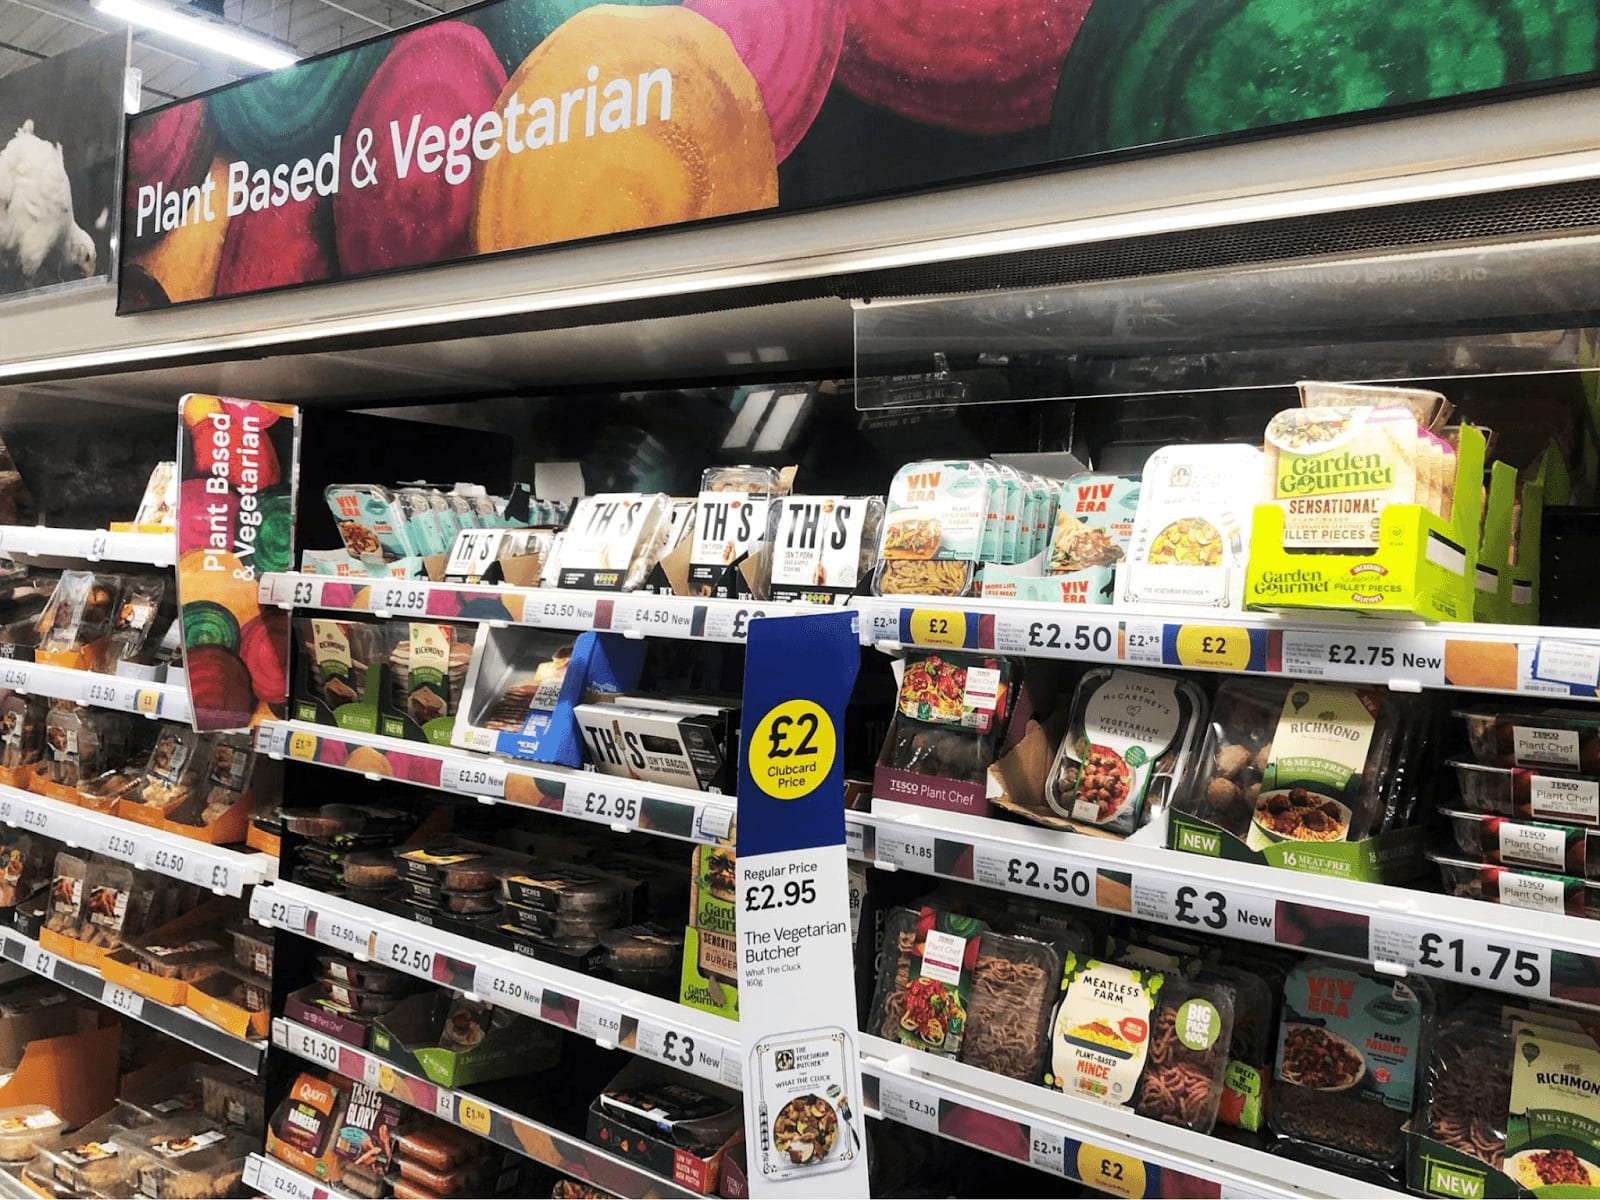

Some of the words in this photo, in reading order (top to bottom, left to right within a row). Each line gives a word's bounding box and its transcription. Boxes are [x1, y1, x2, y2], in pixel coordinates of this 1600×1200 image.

[135, 175, 216, 238] Plant
[226, 136, 340, 217] Based
[351, 128, 378, 189] &
[390, 66, 675, 185] Vegetarian
[206, 413, 230, 494] Based
[1292, 451, 1381, 476] Garden
[234, 416, 263, 558] Vegetarian
[907, 472, 942, 489] VIV
[1280, 466, 1392, 494] Gourmet
[1078, 483, 1115, 500] VIV
[1076, 501, 1107, 513] ERA
[1289, 498, 1379, 515] SENSATIONAL
[204, 503, 228, 572] Plant
[1321, 529, 1365, 540] PIECES
[232, 565, 255, 581] &
[1262, 569, 1322, 584] Garden
[294, 582, 312, 604] £3
[1061, 581, 1089, 593] VIV
[1255, 580, 1328, 597] Gourmet
[1334, 583, 1365, 592] FILLET
[1368, 584, 1402, 593] PIECES
[385, 590, 425, 610] £2.95
[1063, 594, 1087, 604] ERA
[543, 604, 574, 618] £3.50
[576, 608, 593, 619] New
[635, 608, 669, 624] £4.50
[671, 614, 690, 627] New
[873, 617, 898, 628] £2.50
[929, 618, 947, 634] £2
[1028, 622, 1112, 652] £2.50
[1129, 634, 1160, 648] £2.95
[1202, 636, 1226, 654] £2
[1328, 644, 1395, 667] £2.75
[1402, 652, 1442, 669] New
[90, 685, 116, 702] £3.50
[1125, 684, 1156, 695] LINDA
[385, 722, 404, 736] NEW
[1100, 715, 1159, 735] VEGETARIAN
[1100, 725, 1153, 743] MEATBALLS
[1290, 722, 1361, 742] RICHMOND
[767, 712, 819, 759] £2
[1519, 740, 1546, 751] Plant
[1547, 742, 1574, 753] Chef
[459, 770, 487, 785] £2.50
[488, 776, 504, 787] New
[767, 762, 817, 777] Clubcard
[778, 777, 806, 789] Price
[890, 779, 919, 793] TESCO
[920, 784, 947, 801] Plant
[948, 790, 975, 806] Chef
[585, 792, 637, 821] £2.95
[1536, 790, 1564, 801] Plant
[1566, 793, 1594, 804] Chef
[24, 809, 47, 828] £2.50
[108, 835, 136, 857] £2.50
[904, 842, 932, 859] £1.85
[1183, 832, 1217, 851] NEW
[1504, 838, 1531, 850] Plant
[1533, 842, 1560, 855] Chef
[155, 850, 185, 873] £2.50
[1282, 851, 1297, 867] 16
[1298, 854, 1352, 873] MEAT-FREE
[211, 864, 229, 889] £3
[744, 866, 785, 882] Regular
[788, 862, 818, 875] Price
[1007, 858, 1090, 897] £2.50
[745, 878, 816, 912] £2.95
[1504, 887, 1530, 900] Plant
[1532, 892, 1559, 904] Chef
[704, 901, 737, 920] Gard
[1175, 886, 1228, 930] £3
[1237, 908, 1273, 929] New
[331, 924, 354, 942] £2.50
[744, 931, 771, 945] The
[773, 920, 847, 943] Vegetarian
[703, 932, 737, 953] SENSATIO
[36, 953, 50, 973] £2
[391, 943, 431, 973] £2.50
[745, 944, 801, 963] Butcher
[1419, 932, 1541, 988] £1.75
[745, 968, 765, 978] What
[767, 965, 780, 975] The
[781, 962, 802, 973] Cluck
[493, 978, 522, 998] £2.50
[523, 990, 541, 1004] New
[1083, 975, 1140, 998] MEATLESS
[1093, 988, 1124, 1004] FARM
[1307, 976, 1356, 1000] VIV
[1187, 1003, 1211, 1024] BIG
[1307, 995, 1350, 1019] ERA
[598, 1016, 619, 1031] £2.50
[1186, 1020, 1210, 1036] PACK
[1185, 1032, 1208, 1048] 400g
[303, 1036, 337, 1064] £1.30
[662, 1031, 695, 1067] £3
[699, 1052, 721, 1069] New
[1075, 1049, 1117, 1067] PLANT-BASED
[1077, 1060, 1110, 1080] MINCE
[775, 1080, 796, 1089] WHAT
[810, 1074, 831, 1083] CLUCK
[1232, 1080, 1252, 1094] TACOS
[1536, 1072, 1600, 1095] RICHMON
[300, 1083, 327, 1104] Quorn
[352, 1081, 377, 1107] TASTE
[441, 1097, 450, 1110] £2
[908, 1100, 936, 1117] £2.30
[346, 1102, 379, 1131] GLORY
[1033, 1140, 1062, 1154] £2.95
[1101, 1158, 1124, 1181] £2
[274, 1177, 298, 1195] £2.50
[1436, 1172, 1480, 1197] NEW
